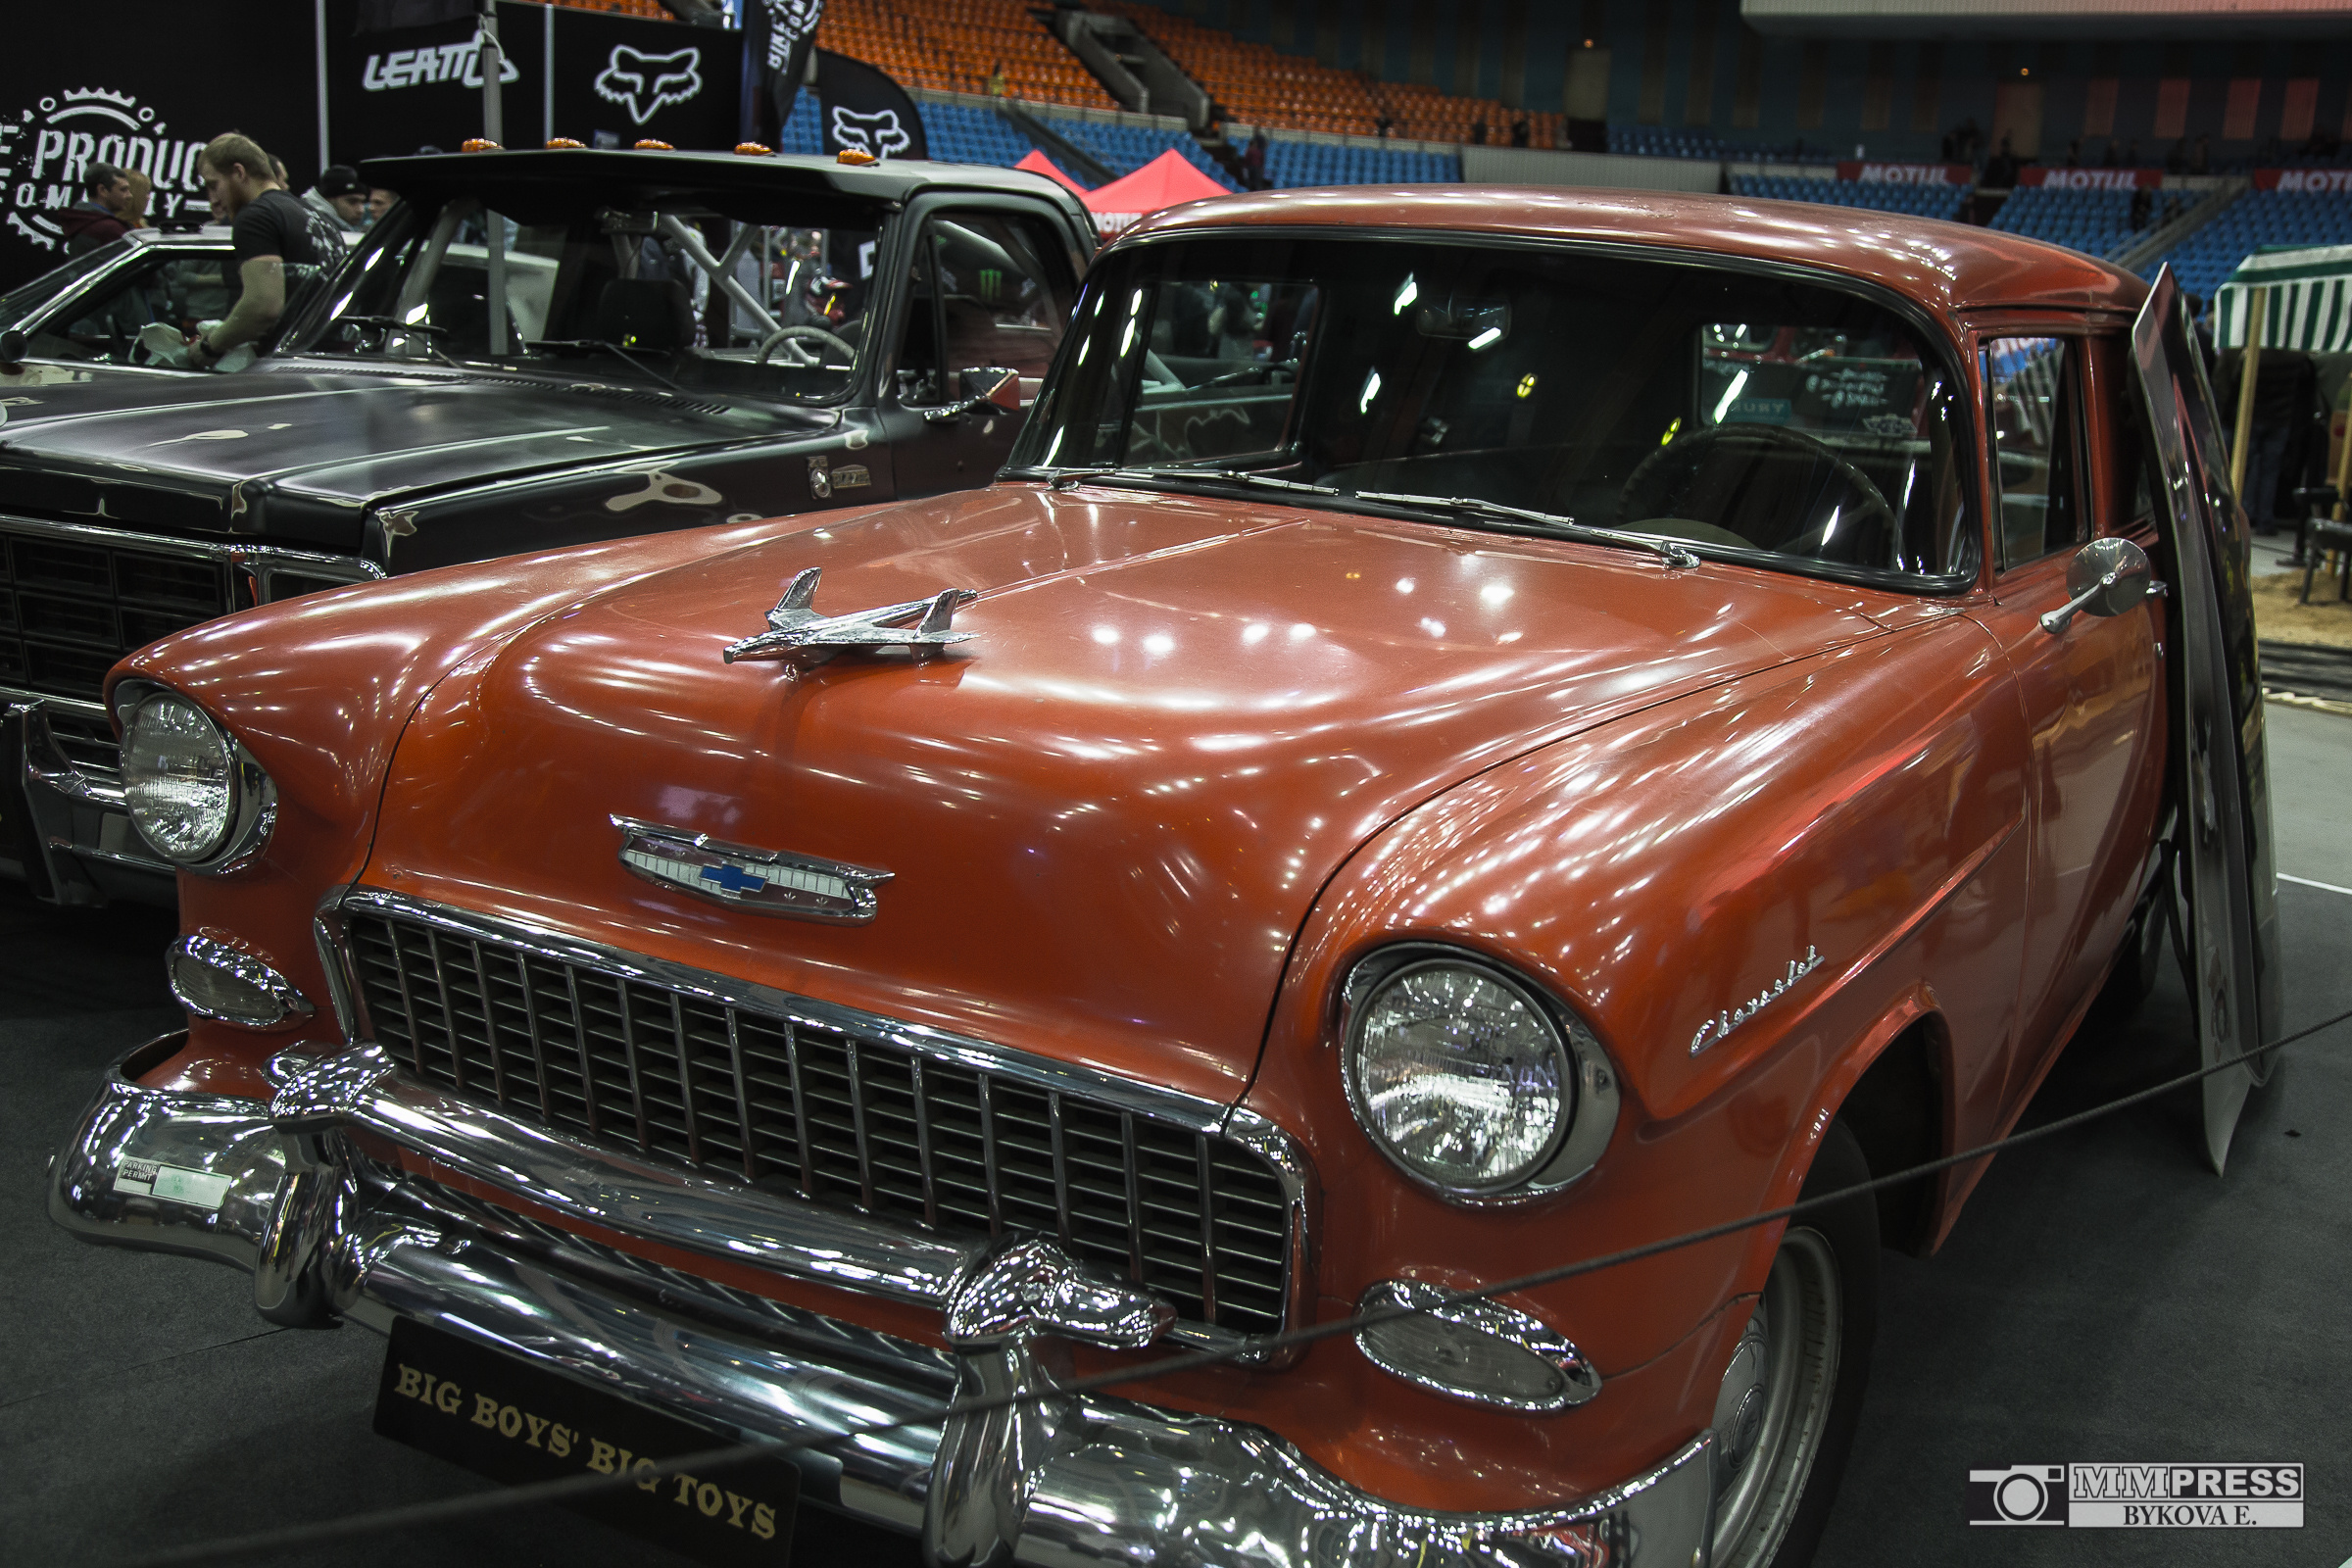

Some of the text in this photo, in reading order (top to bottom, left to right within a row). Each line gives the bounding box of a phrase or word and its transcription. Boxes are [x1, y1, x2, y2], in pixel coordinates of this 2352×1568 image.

[1857, 164, 1949, 186] MOTUL
[2043, 169, 2137, 190] MOTUL
[122, 1169, 152, 1181] PERMIT
[123, 1160, 158, 1174] PARKING
[394, 1363, 776, 1540] BIG BOYS' BIG TOYS
